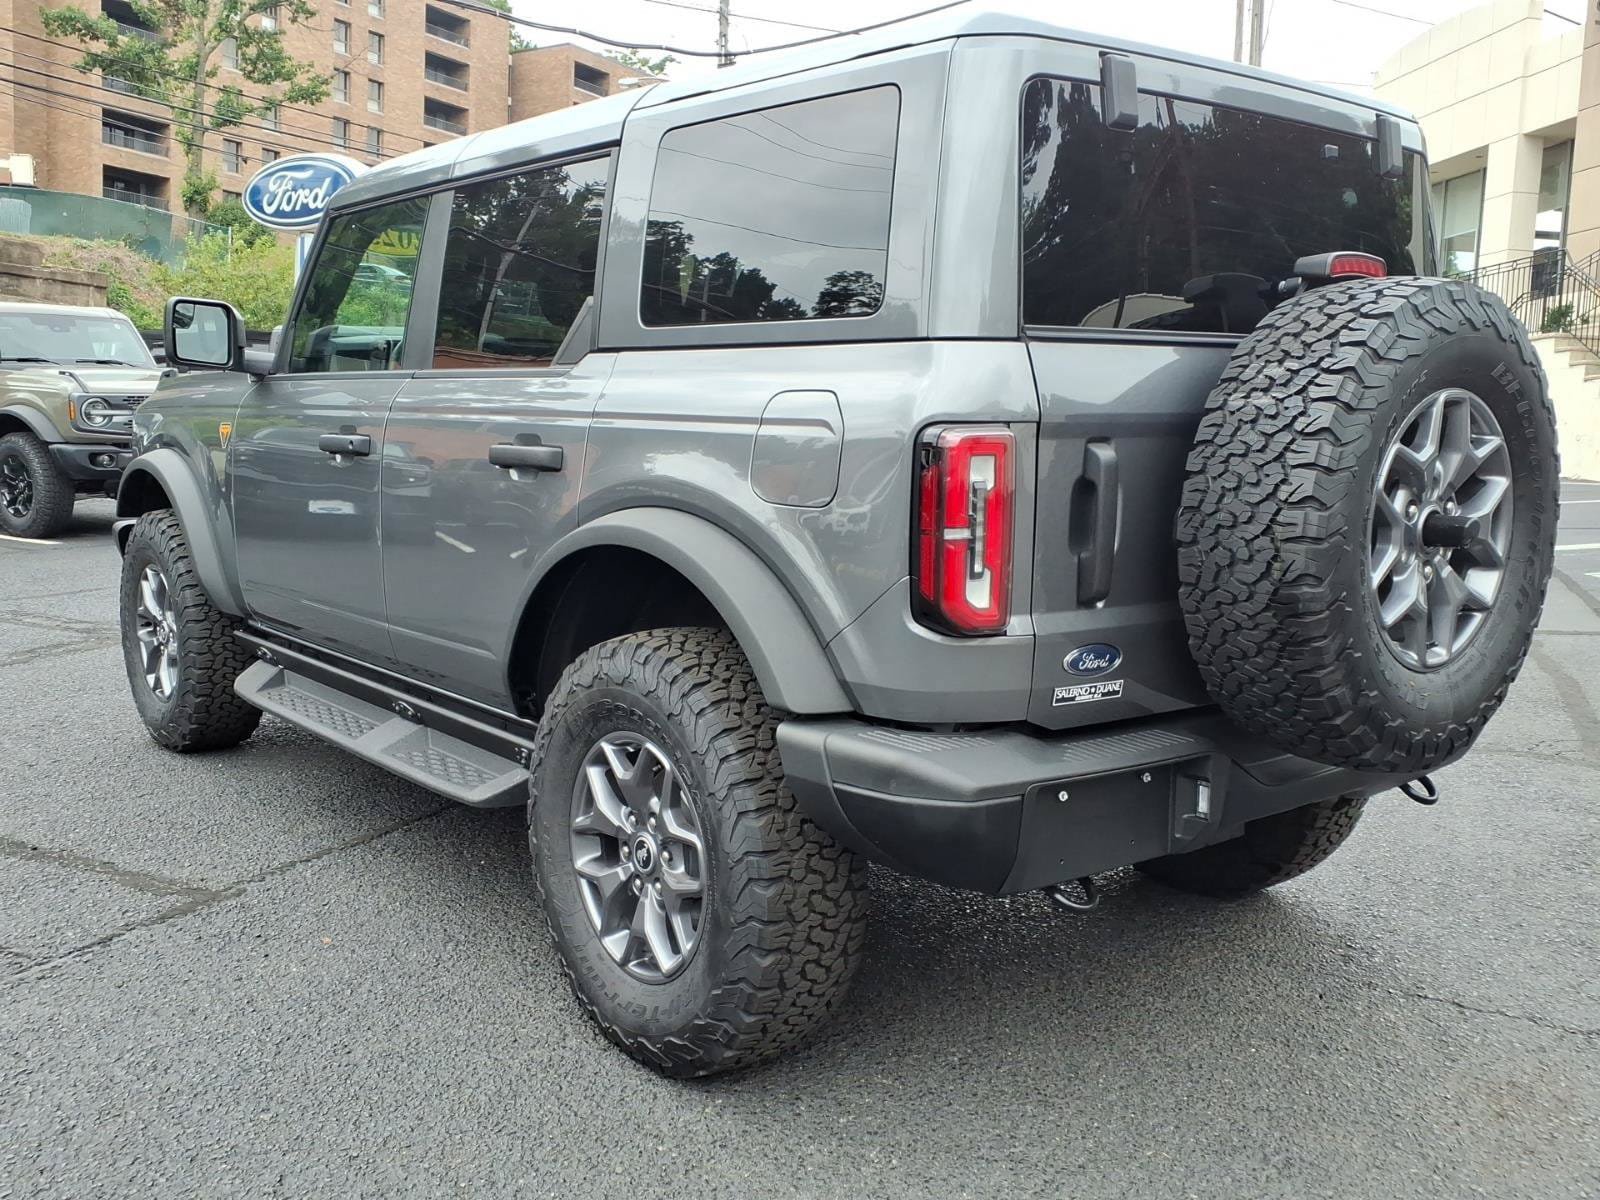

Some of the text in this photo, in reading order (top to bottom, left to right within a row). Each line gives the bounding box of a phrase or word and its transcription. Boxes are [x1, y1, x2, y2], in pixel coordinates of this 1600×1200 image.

[262, 169, 331, 214] Ford
[1079, 652, 1109, 670] Ford
[1056, 686, 1090, 699] SALERNO
[1096, 682, 1120, 693] DUANE
